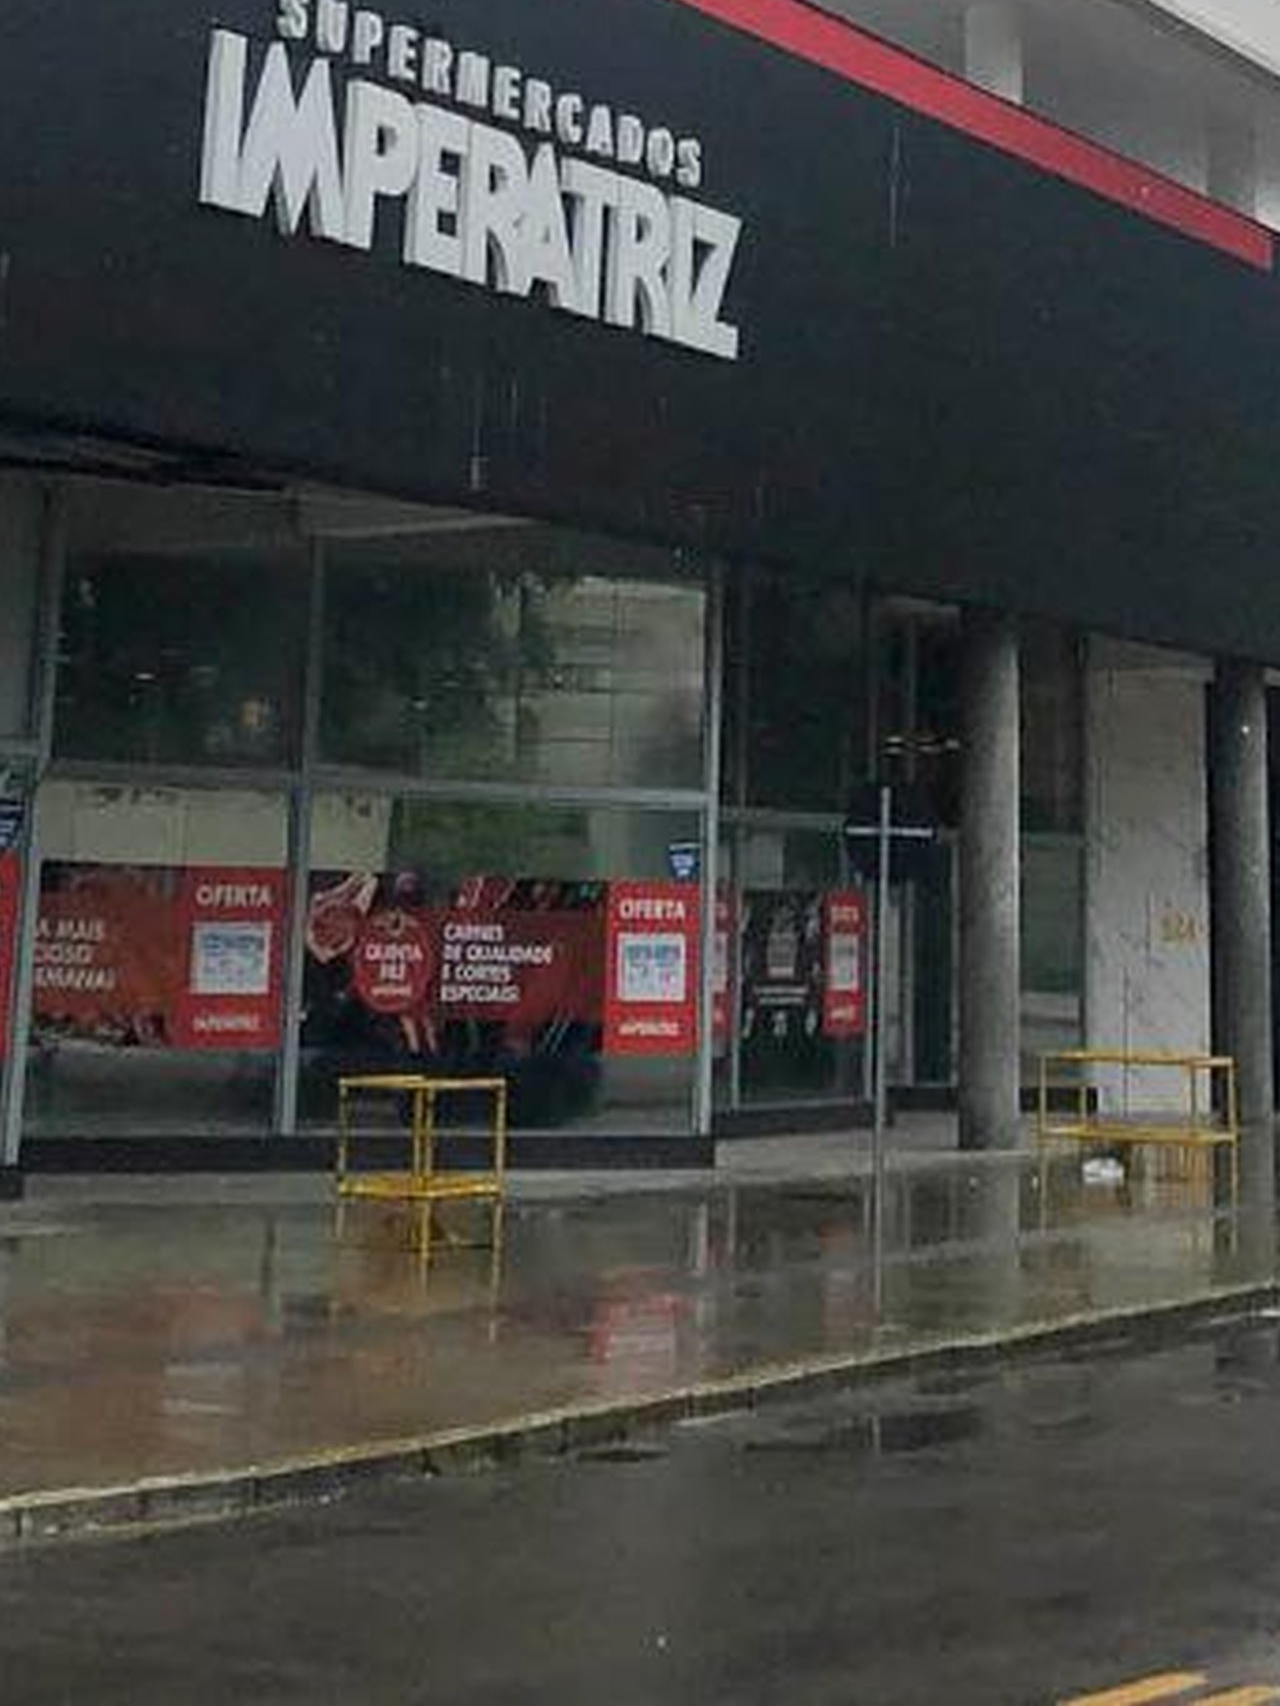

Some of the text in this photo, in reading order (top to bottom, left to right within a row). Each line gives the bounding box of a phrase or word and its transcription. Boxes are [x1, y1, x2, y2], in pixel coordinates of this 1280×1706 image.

[200, 28, 742, 359] IMPERATRIZ
[195, 883, 272, 907] OFERTA
[620, 899, 686, 920] OFERTA
[443, 923, 503, 941] CARNES
[466, 945, 553, 964] QUALIDADE
